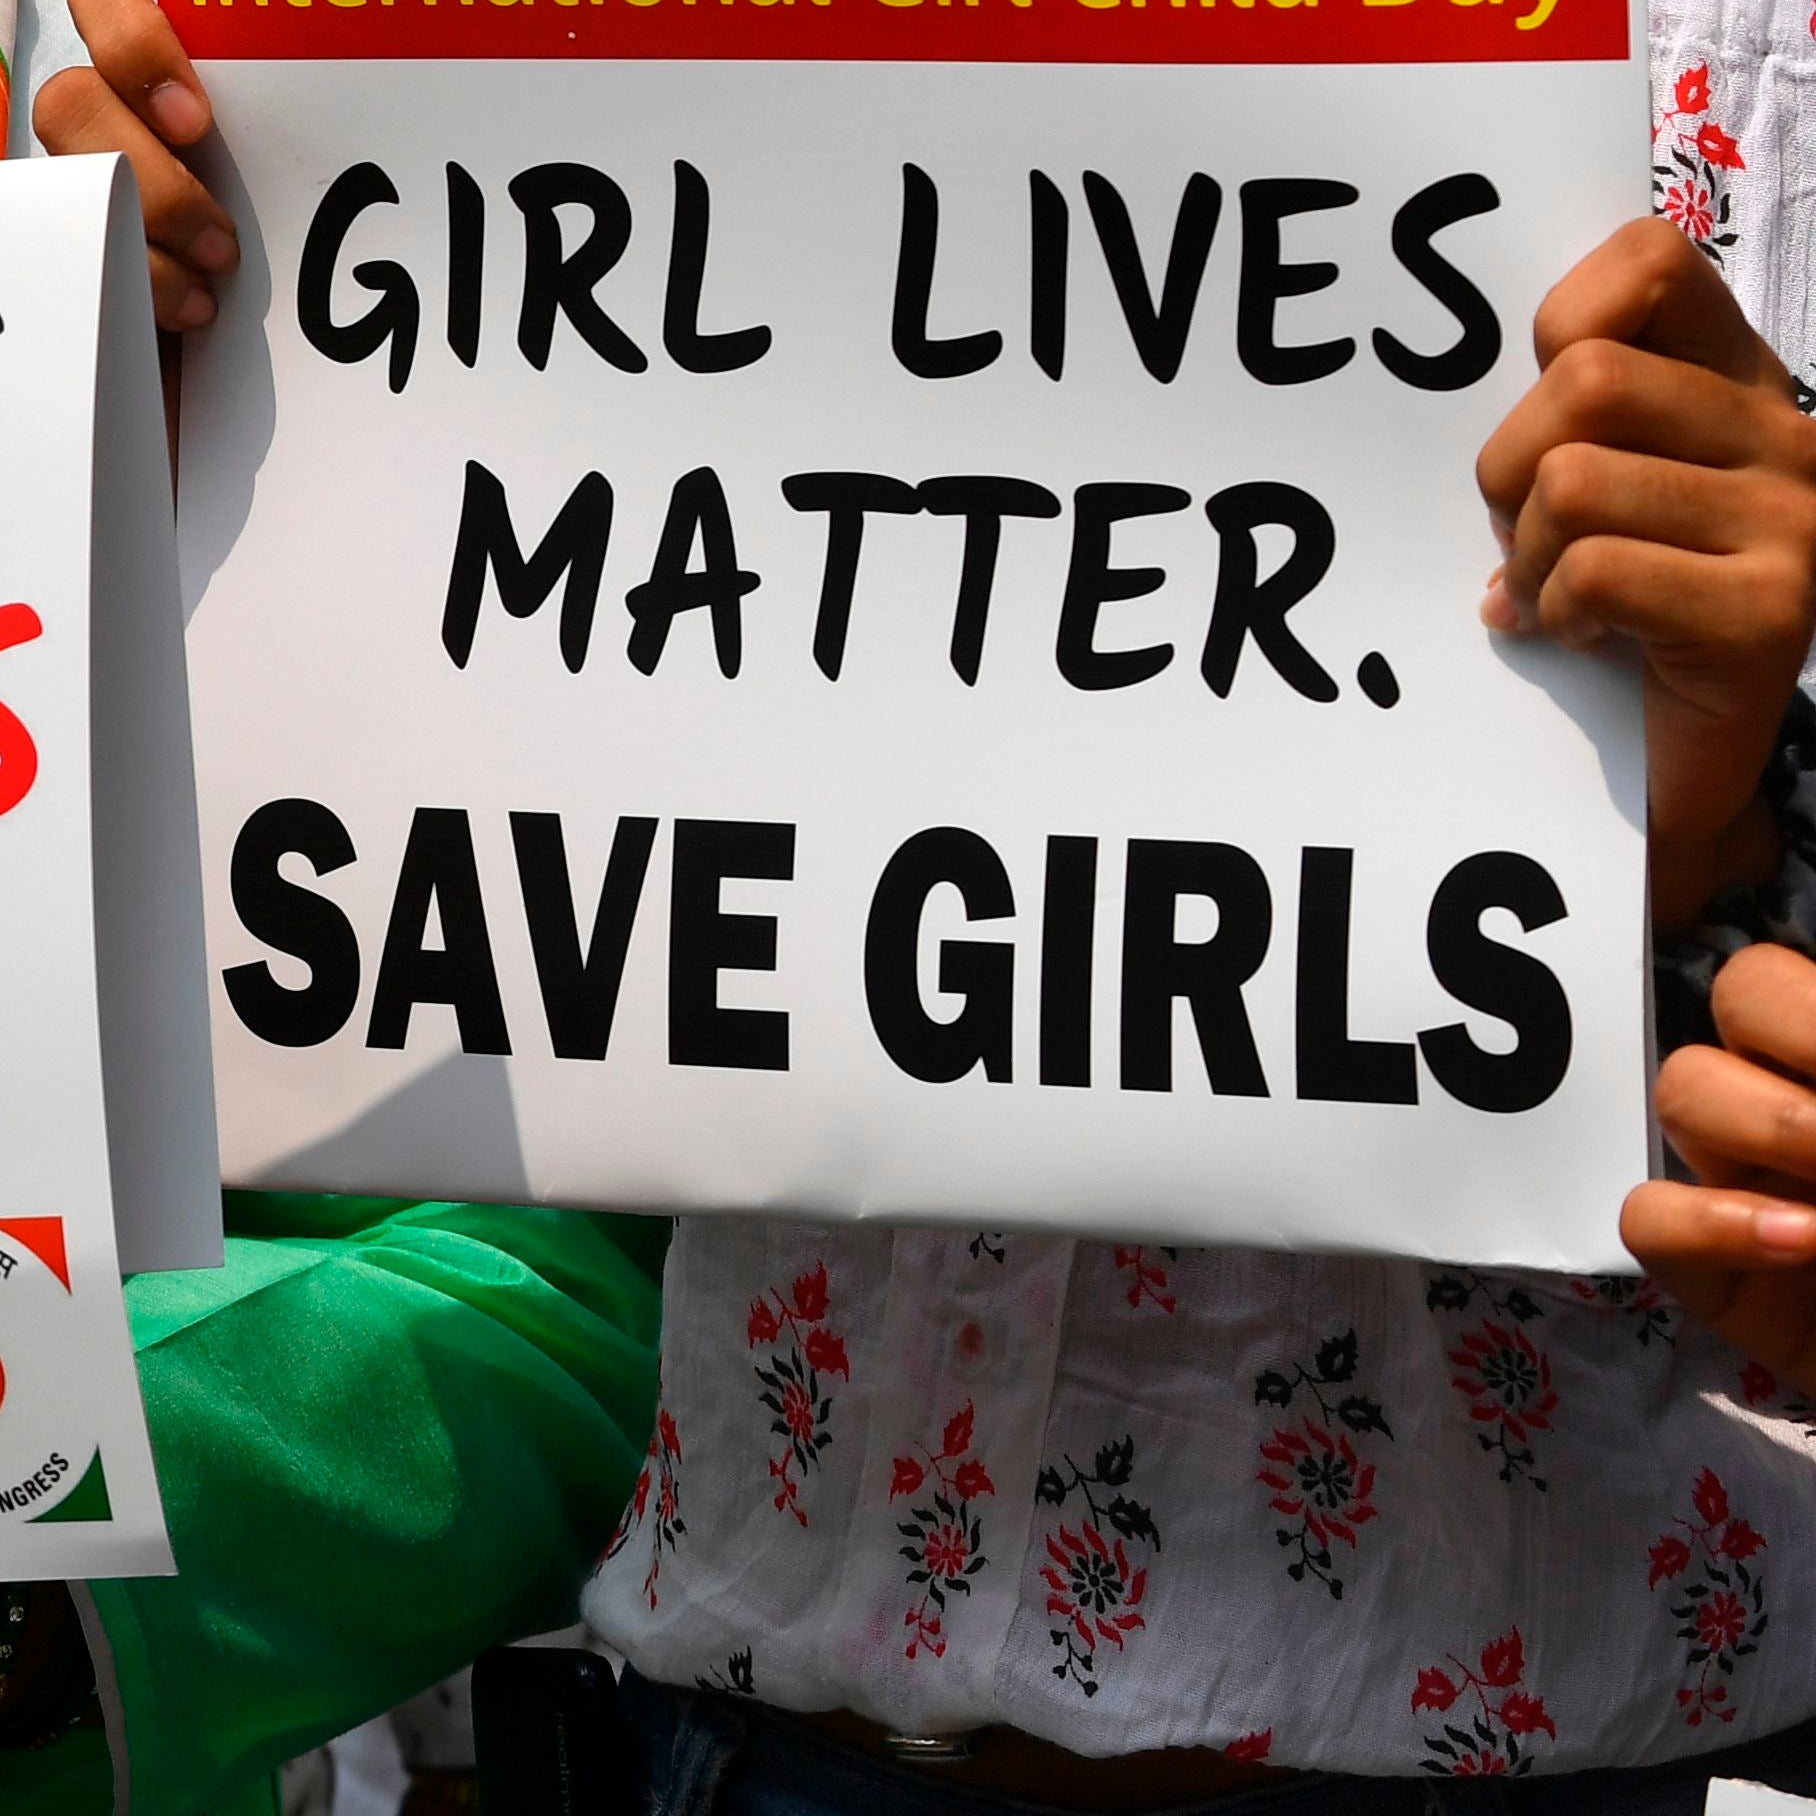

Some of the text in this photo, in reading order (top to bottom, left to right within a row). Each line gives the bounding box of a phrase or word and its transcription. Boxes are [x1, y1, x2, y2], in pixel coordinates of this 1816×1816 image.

[297, 159, 1502, 395] GIRL LIVES
[441, 459, 1400, 709] MATTER.
[221, 798, 1573, 1114] SAVE GIRLS
